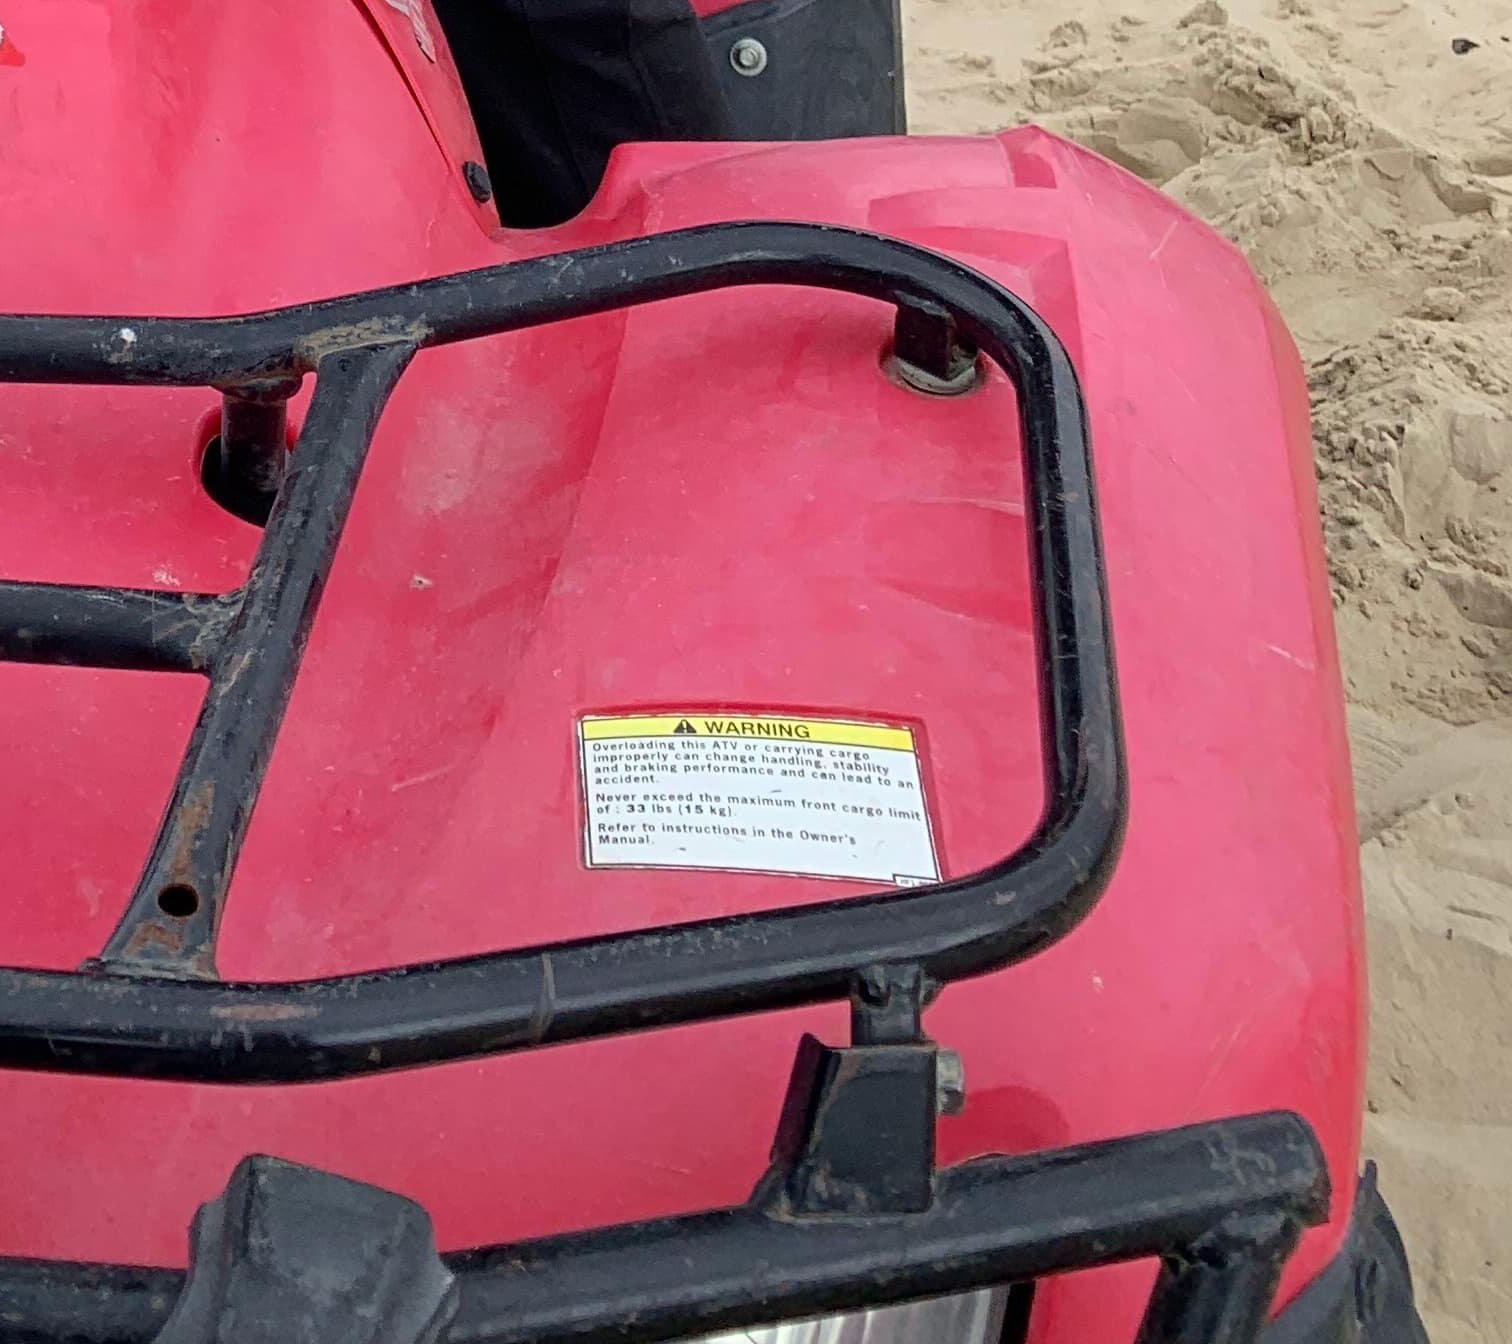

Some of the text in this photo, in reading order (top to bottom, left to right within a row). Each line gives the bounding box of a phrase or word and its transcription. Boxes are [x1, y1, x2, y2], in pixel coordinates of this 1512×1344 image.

[704, 720, 810, 738] WARNING
[593, 740, 870, 761] Overloading this ATV or carrying cargo
[593, 751, 668, 763] improperly
[675, 753, 699, 761] can
[705, 752, 755, 763] change
[833, 761, 889, 776] stability
[594, 762, 914, 789] and braking performance and can lead to an
[595, 774, 659, 785] accident.
[596, 792, 921, 822] Never exceed the maximum front cargo limit
[597, 804, 611, 814] of
[626, 804, 646, 813] 33
[652, 804, 672, 813] lbs
[678, 804, 703, 816] (15
[598, 823, 856, 846] Refer to instructions in the Owner's
[599, 834, 655, 845] Manual.
